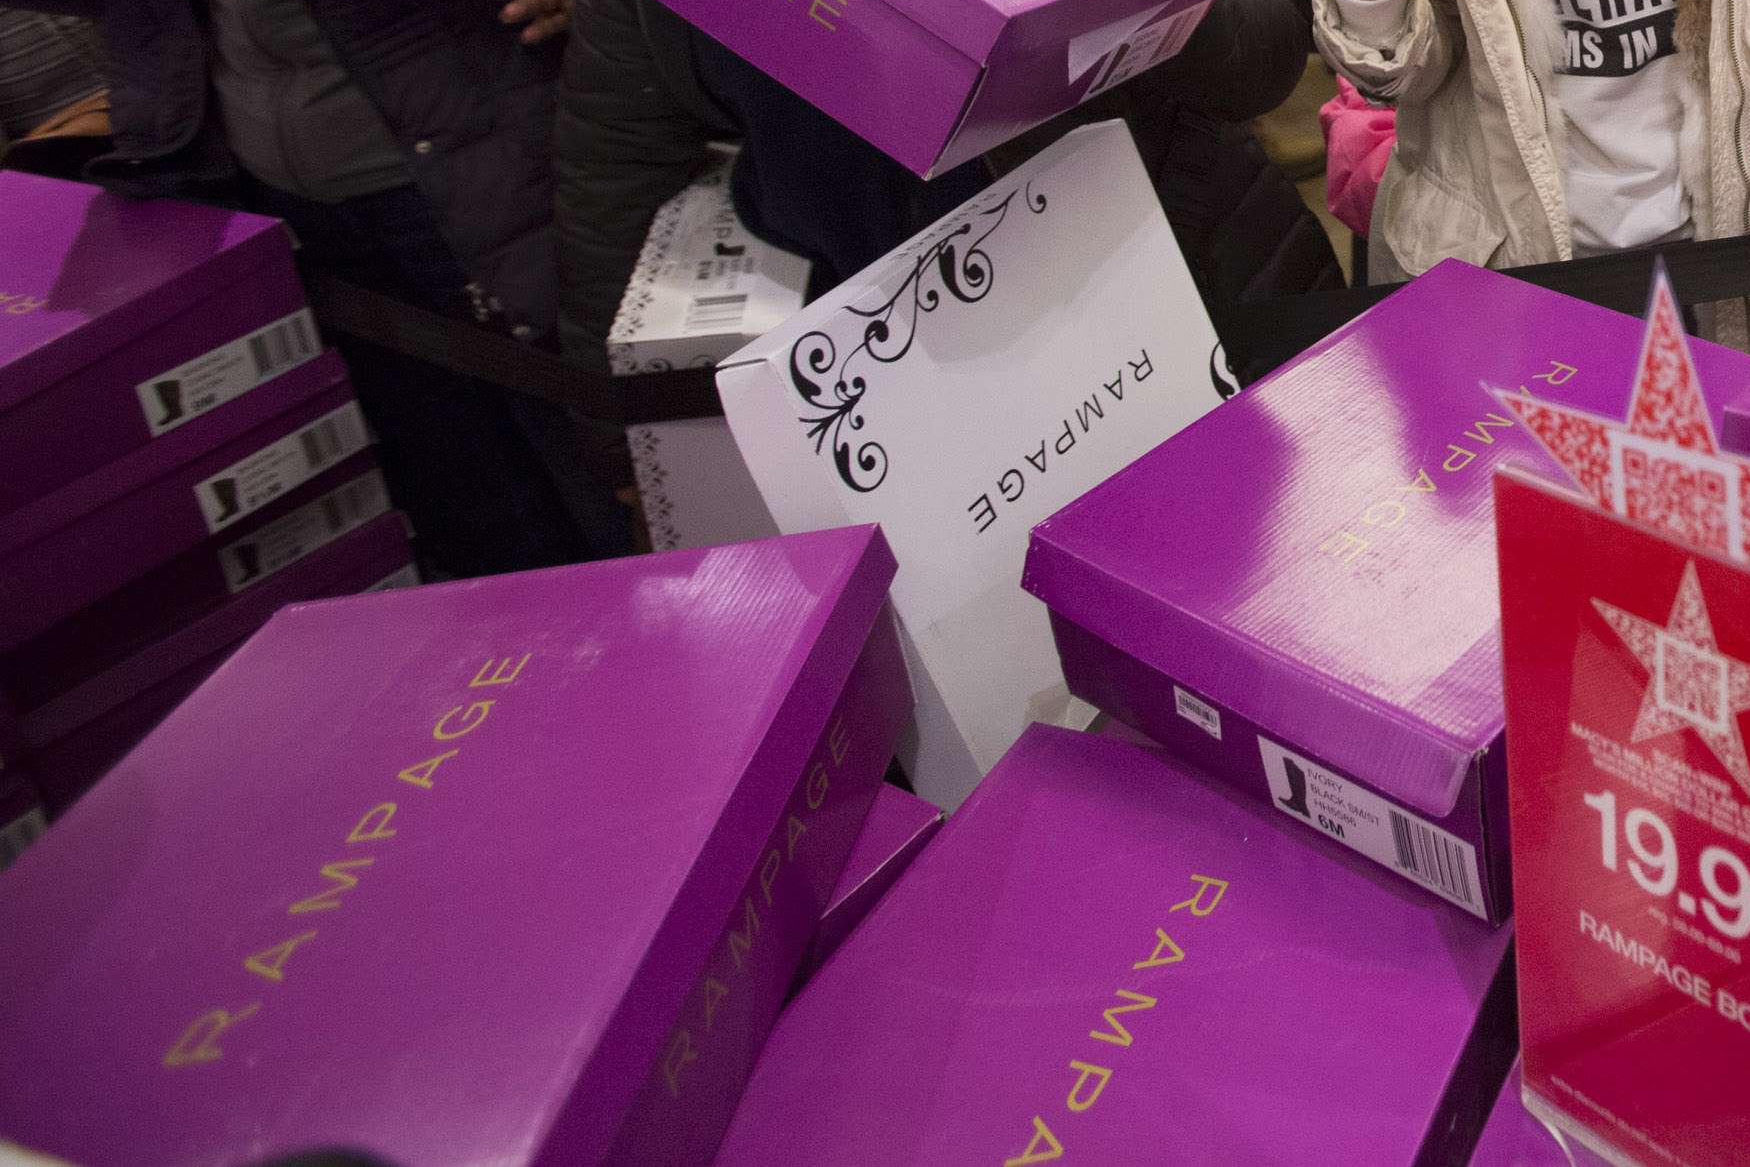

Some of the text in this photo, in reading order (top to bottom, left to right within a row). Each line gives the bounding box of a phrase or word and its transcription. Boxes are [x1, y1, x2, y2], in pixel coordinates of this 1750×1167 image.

[1618, 25, 1658, 69] IN
[966, 348, 1155, 535] RAMPAGE
[1319, 360, 1579, 564] RMPAGE
[1307, 768, 1343, 793] IVORY
[1310, 783, 1346, 809] BLACK
[1318, 813, 1346, 839] 6M
[162, 651, 534, 1070] RAMPAGE
[664, 717, 850, 1097] RAMPAGE
[1004, 873, 1230, 1167] RAMPA
[1579, 909, 1712, 1007] RAMPAGE
